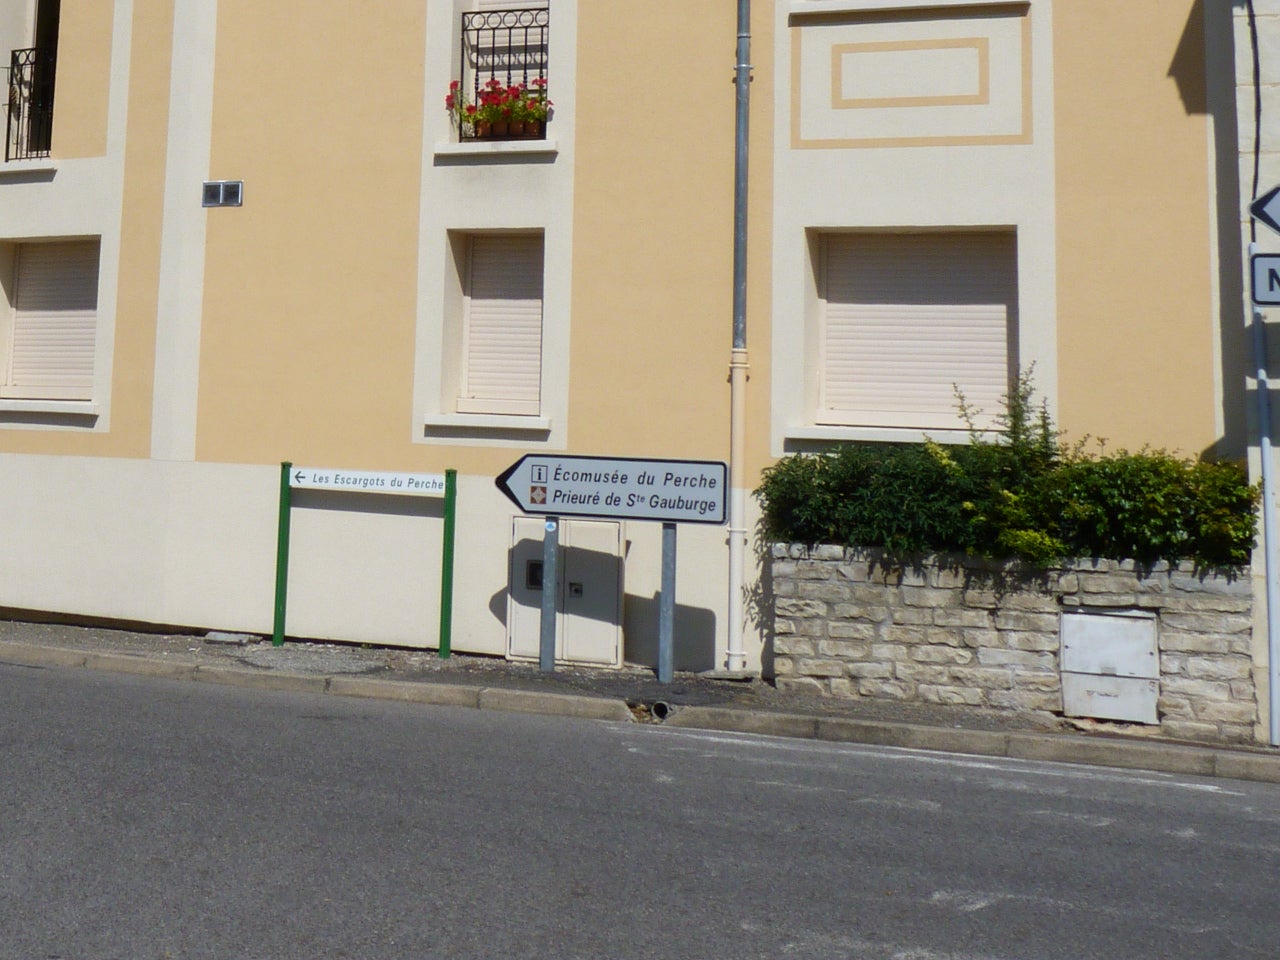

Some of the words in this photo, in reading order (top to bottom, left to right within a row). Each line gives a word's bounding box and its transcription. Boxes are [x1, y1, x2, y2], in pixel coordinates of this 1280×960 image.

[312, 473, 329, 483] Les
[334, 474, 385, 488] Escargots
[390, 477, 403, 487] du
[407, 477, 444, 490] Perche
[553, 464, 628, 484] Écomusée
[637, 471, 655, 485] du
[663, 472, 717, 488] Perche
[553, 489, 600, 505] Prieuré
[605, 492, 621, 506] de
[626, 493, 646, 507] Ste
[649, 494, 716, 515] Gauburge
